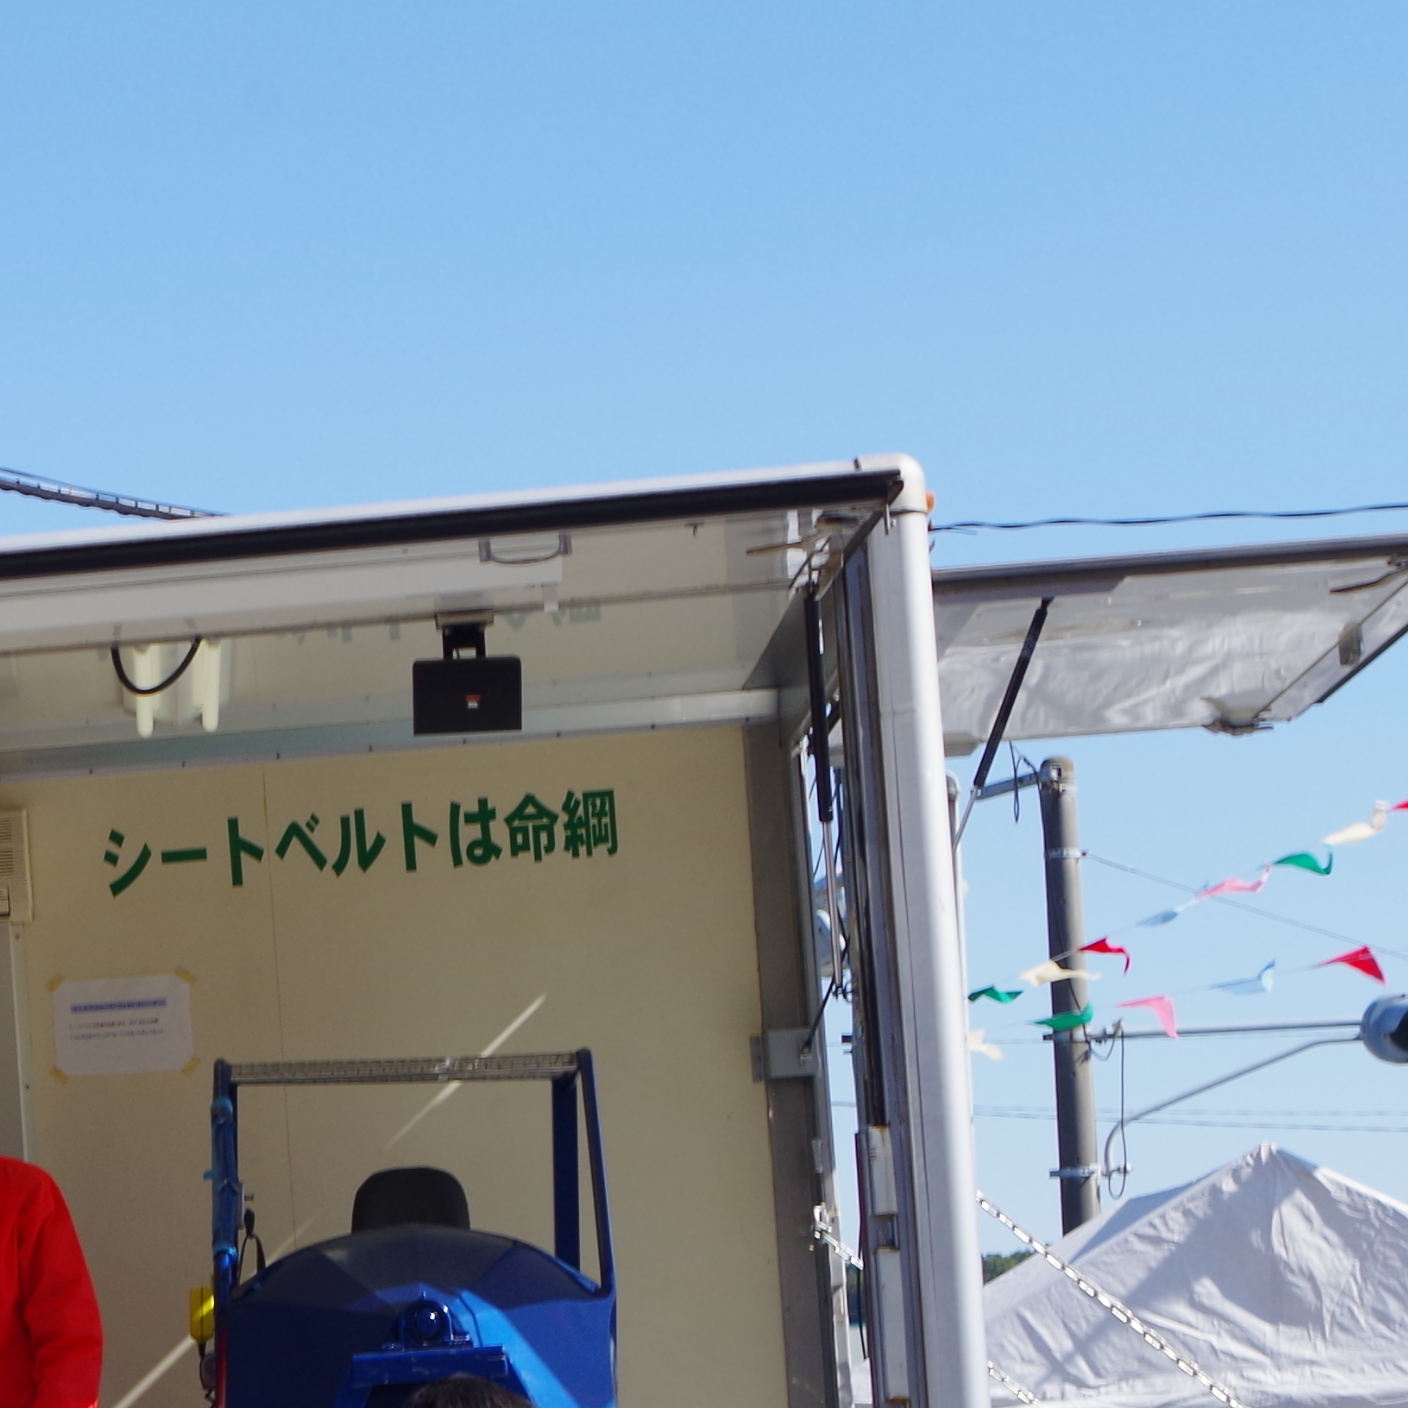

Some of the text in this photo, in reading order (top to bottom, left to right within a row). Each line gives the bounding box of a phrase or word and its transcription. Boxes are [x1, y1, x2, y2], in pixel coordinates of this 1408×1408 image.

[102, 788, 620, 898] シートベルトは命綱
